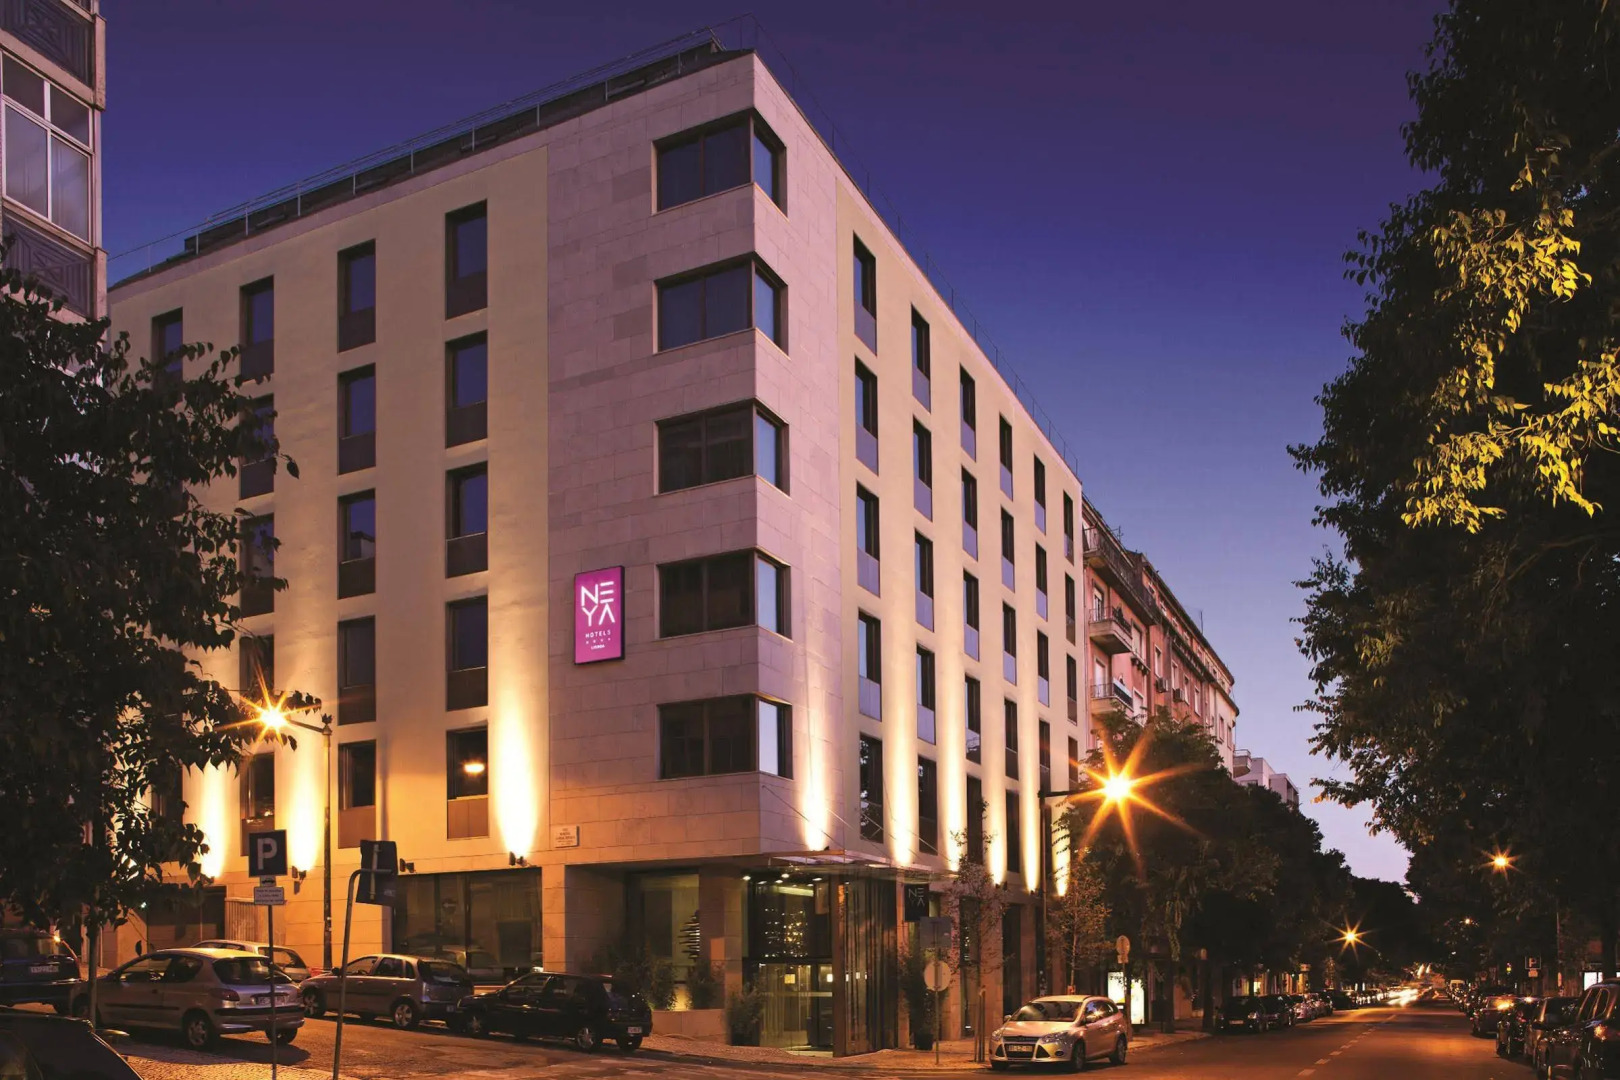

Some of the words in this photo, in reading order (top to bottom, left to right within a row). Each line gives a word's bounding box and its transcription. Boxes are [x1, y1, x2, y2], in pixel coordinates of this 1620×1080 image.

[581, 581, 615, 606] NE
[581, 603, 615, 627] YA
[585, 629, 611, 639] HOTELS
[257, 837, 278, 870] P
